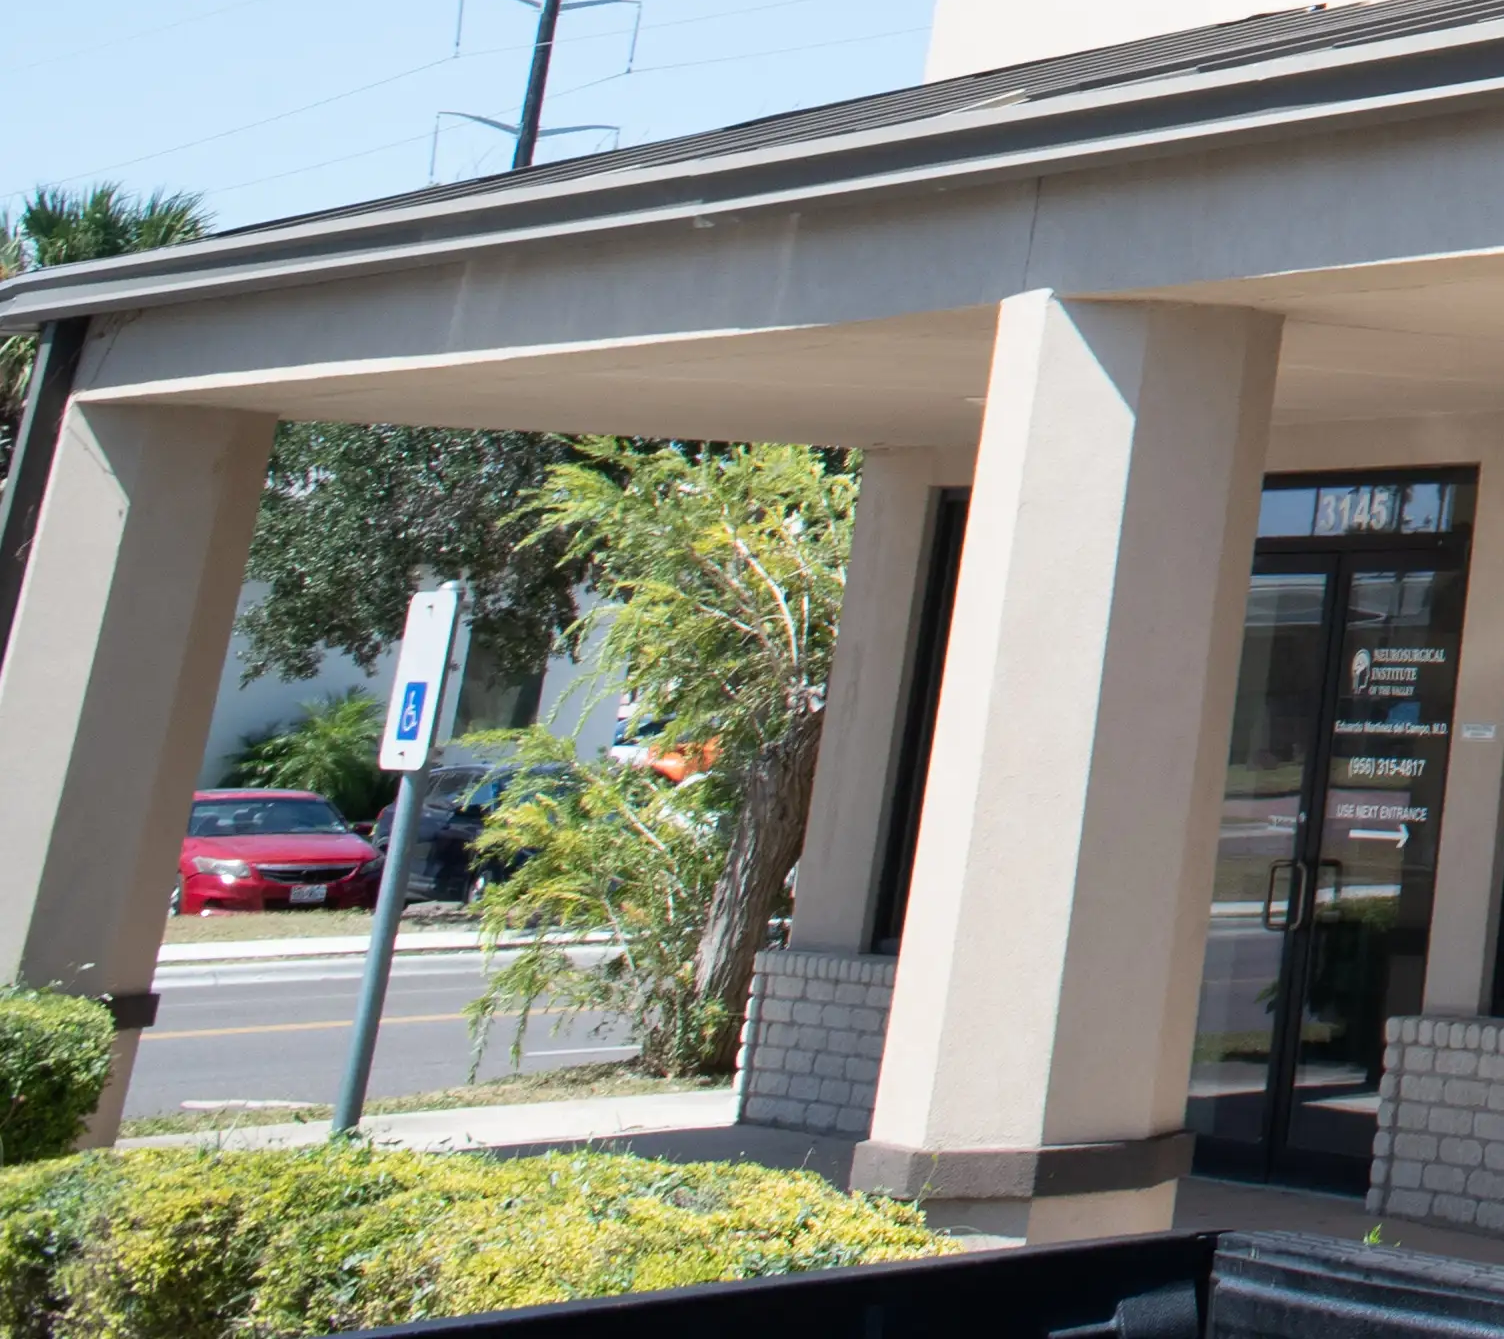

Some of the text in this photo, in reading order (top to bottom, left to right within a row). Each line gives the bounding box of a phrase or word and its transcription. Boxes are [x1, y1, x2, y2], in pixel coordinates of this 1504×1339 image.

[1320, 492, 1390, 531] 3145
[1349, 757, 1426, 778] (956) 315-4817
[1337, 804, 1428, 822] USE NEXT ENTRANCE
